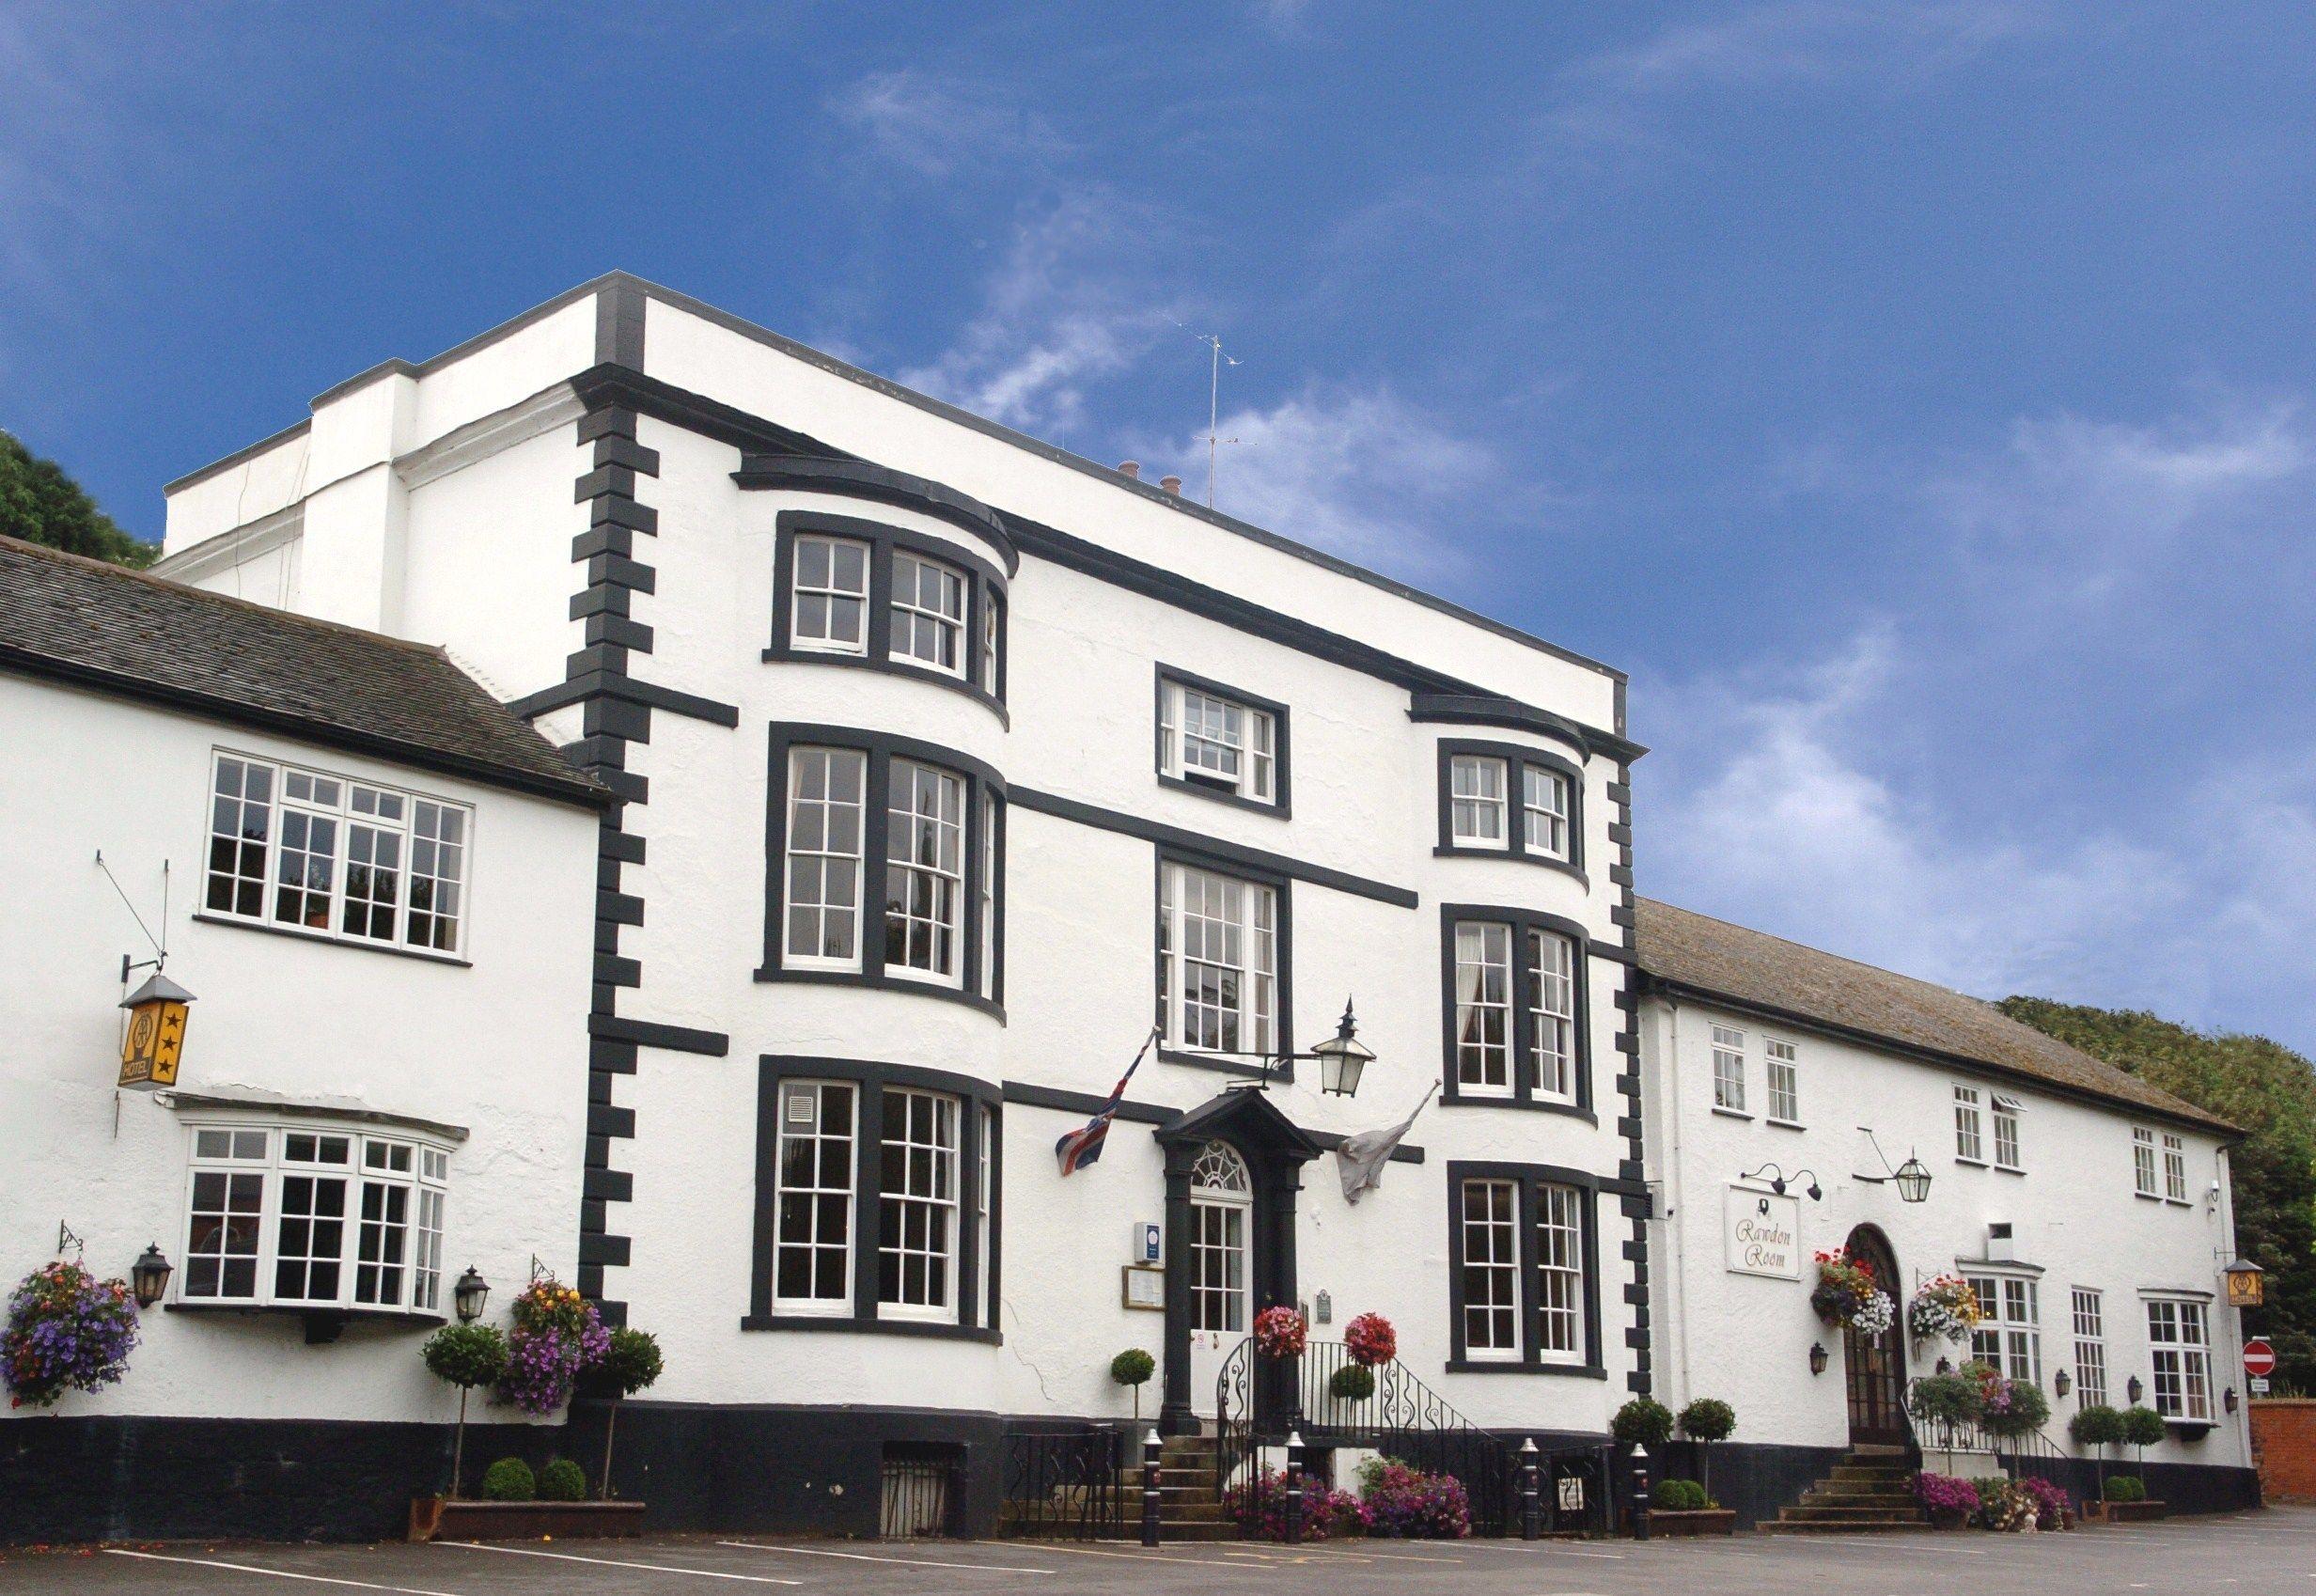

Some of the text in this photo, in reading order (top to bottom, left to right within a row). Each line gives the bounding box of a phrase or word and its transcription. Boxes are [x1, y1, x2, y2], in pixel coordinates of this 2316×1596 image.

[124, 1060, 147, 1077] HOTEL
[1736, 1218, 1791, 1245] Rawdon
[1745, 1244, 1785, 1267] Room
